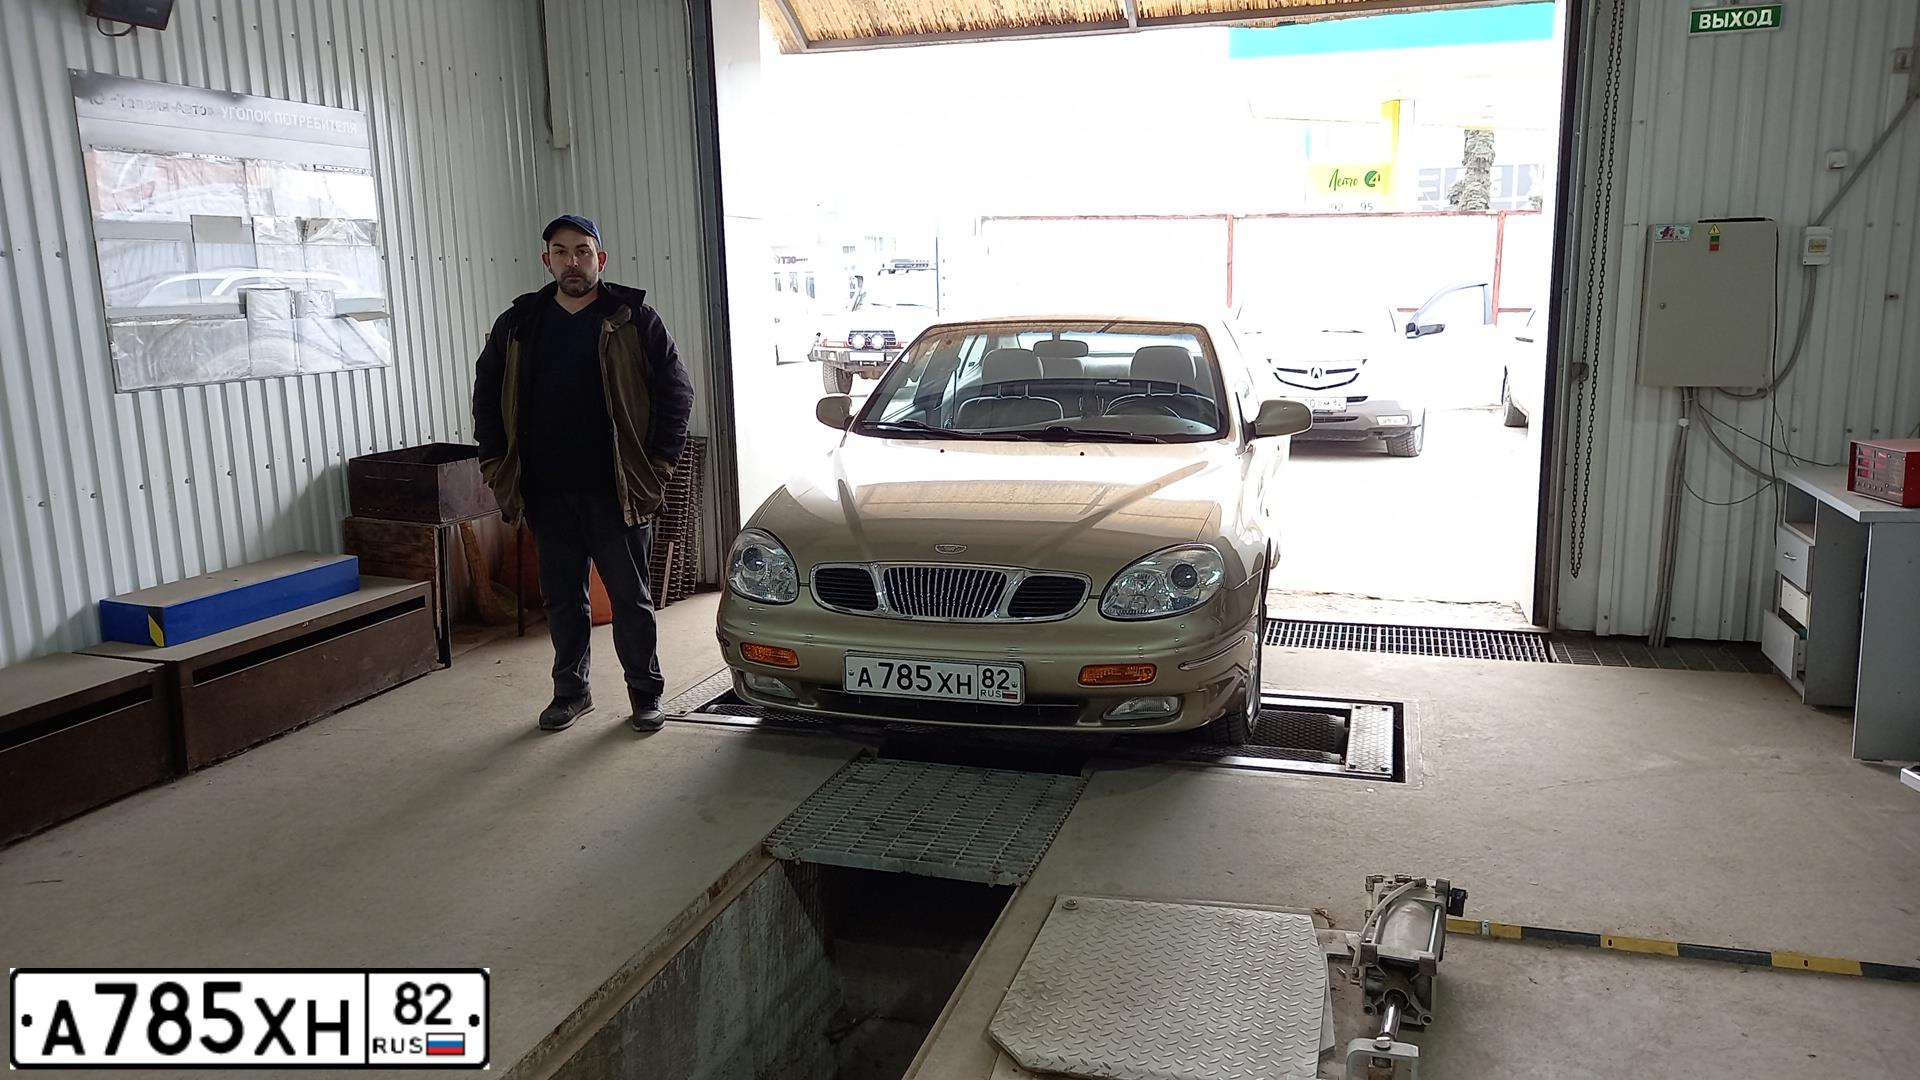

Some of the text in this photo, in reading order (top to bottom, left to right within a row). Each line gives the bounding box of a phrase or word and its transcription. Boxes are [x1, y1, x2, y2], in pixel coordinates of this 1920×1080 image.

[1698, 8, 1773, 30] ВЫХОД
[220, 105, 272, 124] УГОЛОК
[274, 111, 358, 135] ПОТРЕБИТЕЛЯ
[981, 667, 1010, 690] 82
[980, 689, 1002, 699] RUS
